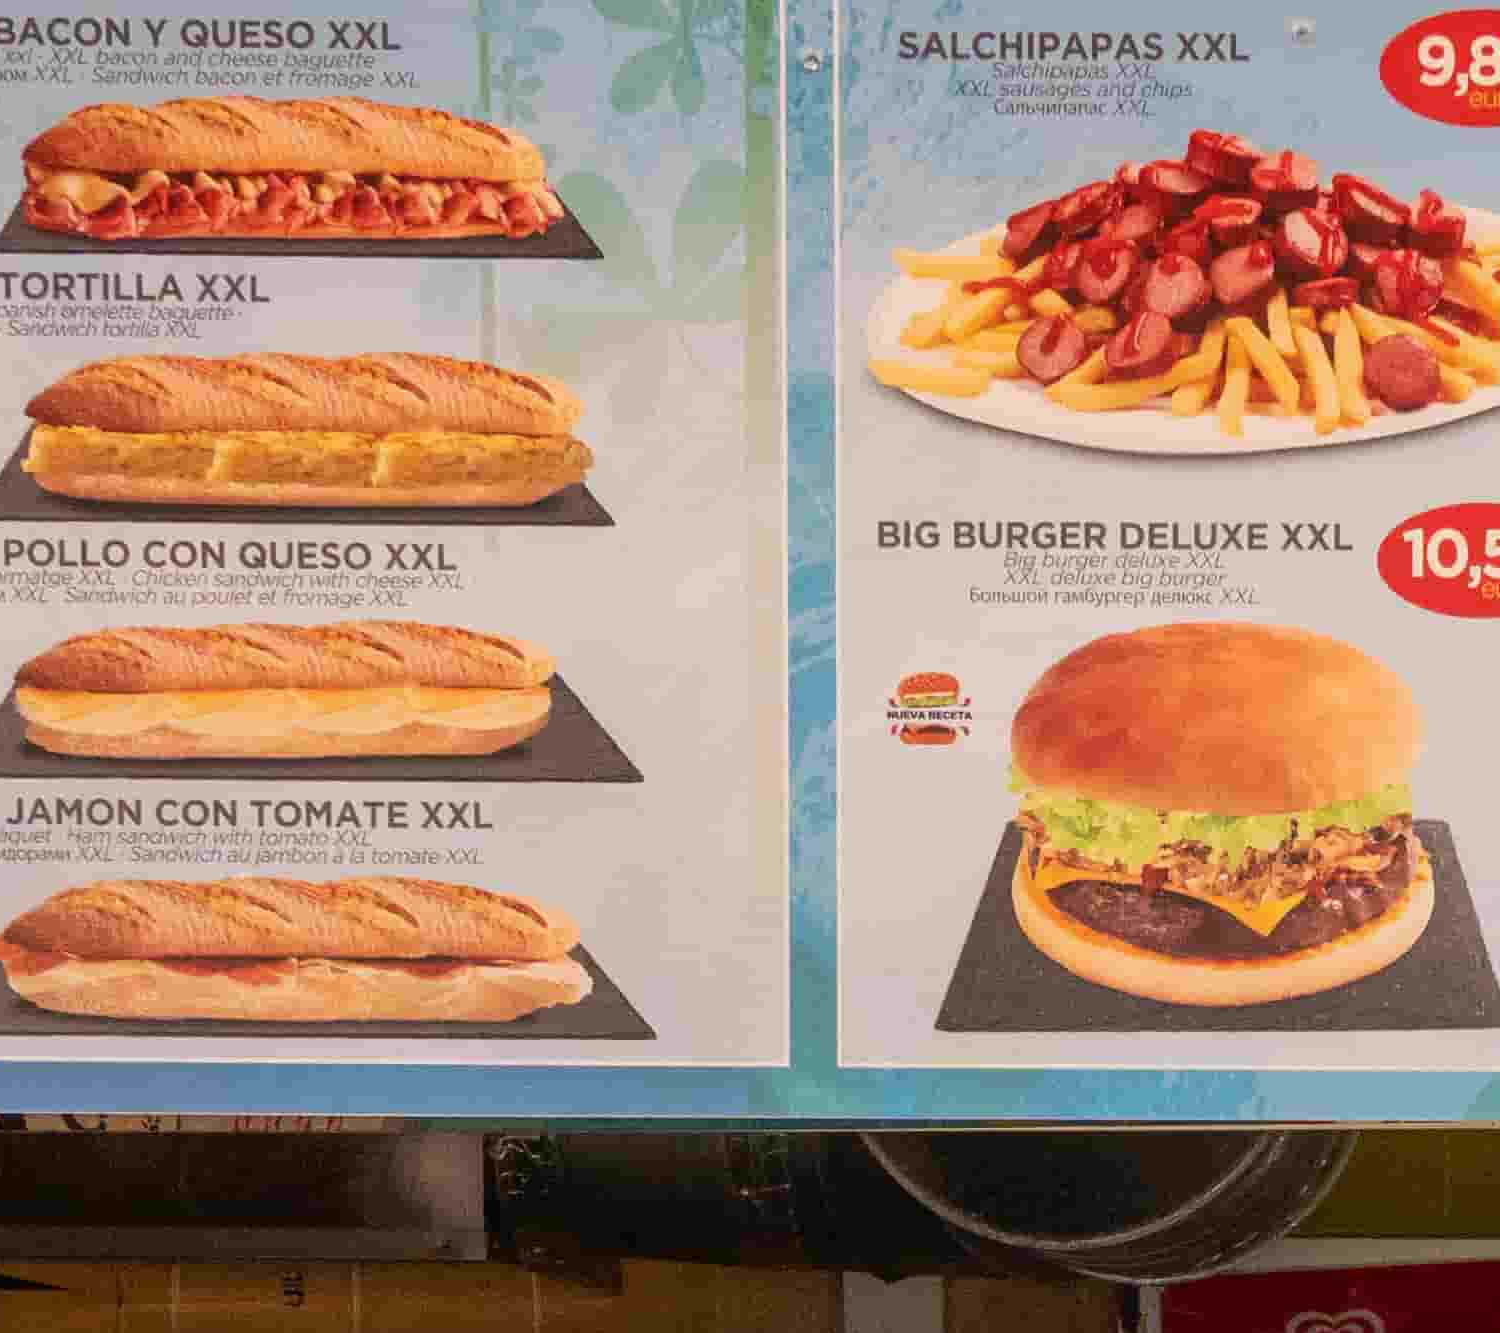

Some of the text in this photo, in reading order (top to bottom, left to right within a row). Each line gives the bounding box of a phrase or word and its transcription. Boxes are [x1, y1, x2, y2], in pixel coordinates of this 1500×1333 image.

[144, 19, 167, 48] Y
[180, 20, 314, 48] QUESO
[328, 21, 401, 50] XXL
[898, 32, 1249, 61] SALCHIPAPAS XXL
[196, 274, 270, 302] XXL
[878, 520, 1353, 550] BIG BURGER DELUXE XXL
[4, 539, 130, 568] POLLO
[144, 541, 224, 568] CON
[239, 541, 371, 570] QUESO
[386, 544, 457, 571] XXL
[1004, 569, 1228, 591] XXL deluxe big burger
[887, 711, 972, 720] NUEVA RECETA
[6, 797, 141, 826] JAMON
[156, 800, 236, 826] CON
[250, 800, 408, 828] TOMATE
[421, 801, 492, 829] XXL
